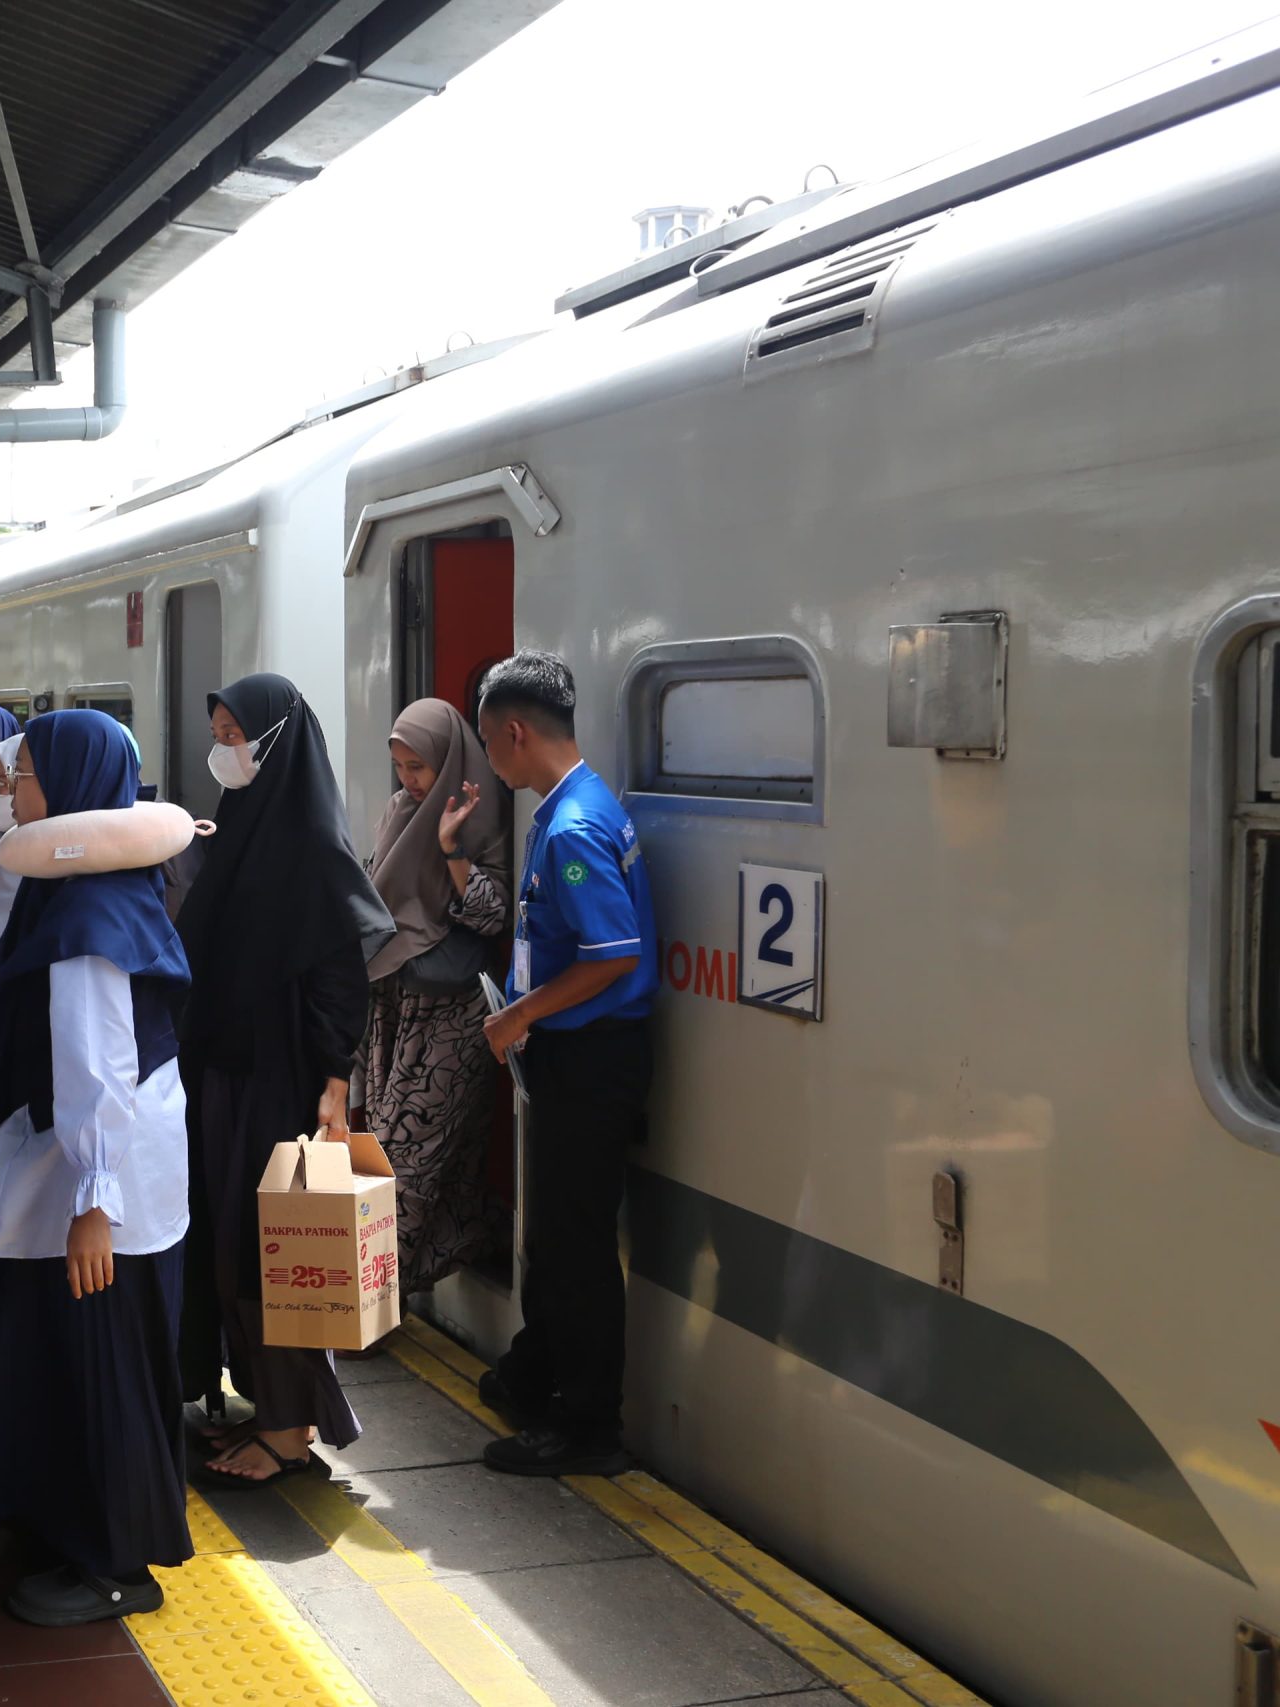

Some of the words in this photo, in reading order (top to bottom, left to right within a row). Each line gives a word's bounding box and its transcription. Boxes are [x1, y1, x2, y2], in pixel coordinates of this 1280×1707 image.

[758, 883, 794, 967] 2
[658, 940, 737, 1003] OMI
[264, 1226, 303, 1236] BAKPIA
[305, 1227, 349, 1237] PATHOK
[290, 1265, 327, 1288] 25
[372, 1254, 387, 1290] 25
